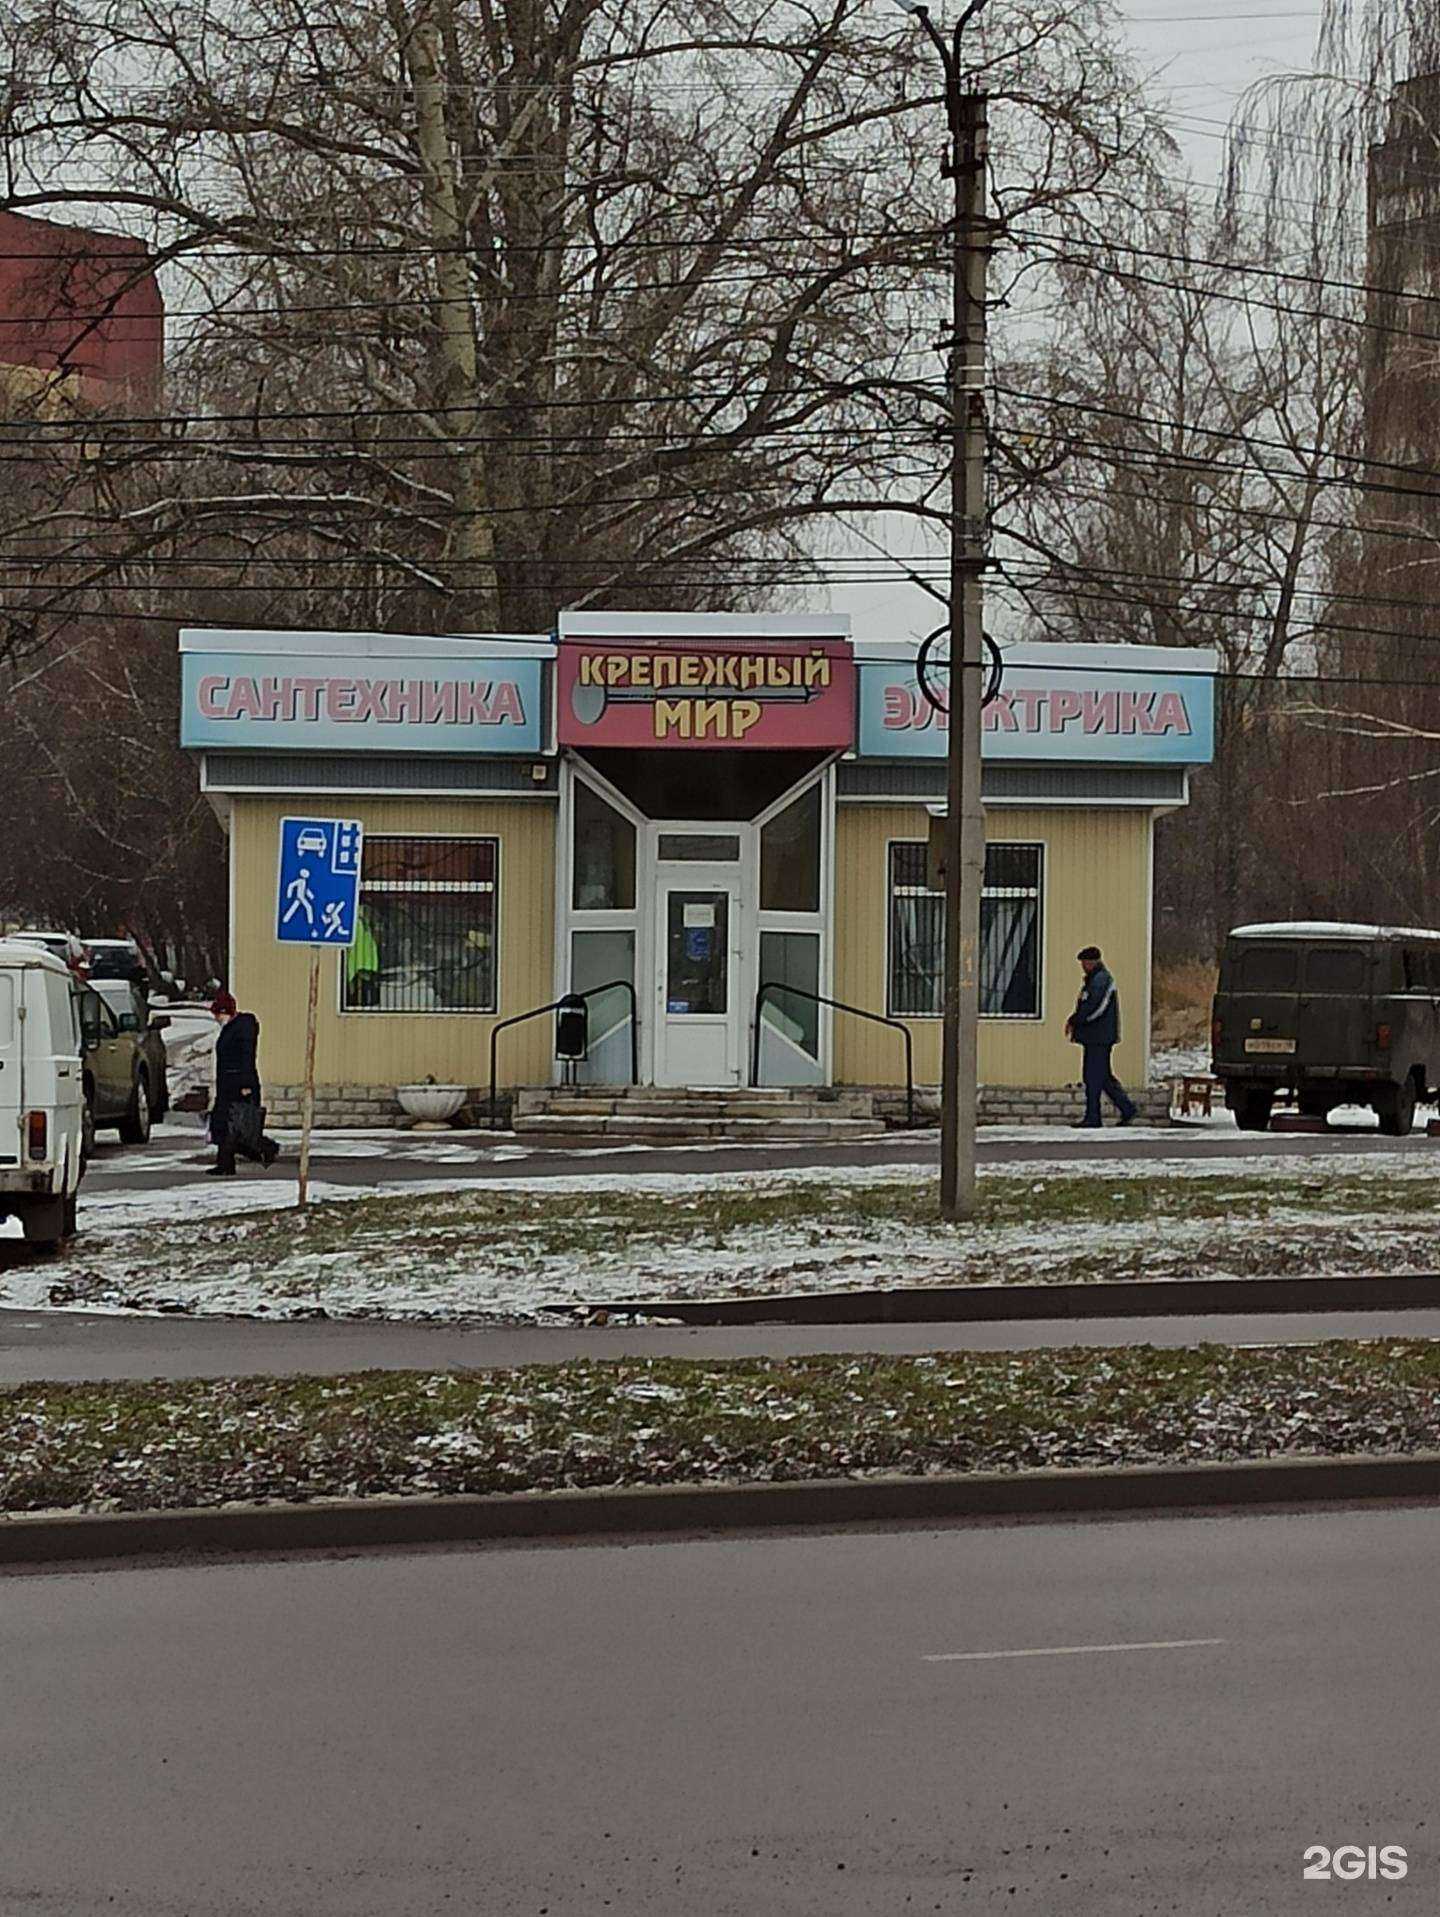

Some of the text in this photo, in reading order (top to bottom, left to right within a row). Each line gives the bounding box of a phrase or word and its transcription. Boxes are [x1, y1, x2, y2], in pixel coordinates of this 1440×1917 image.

[579, 648, 831, 690] КРЕПЕЖНЫЙ
[197, 675, 526, 725] САНТЕХНИКА
[653, 698, 763, 739] МИР
[882, 685, 1192, 735] ЭЛКТРИКА
